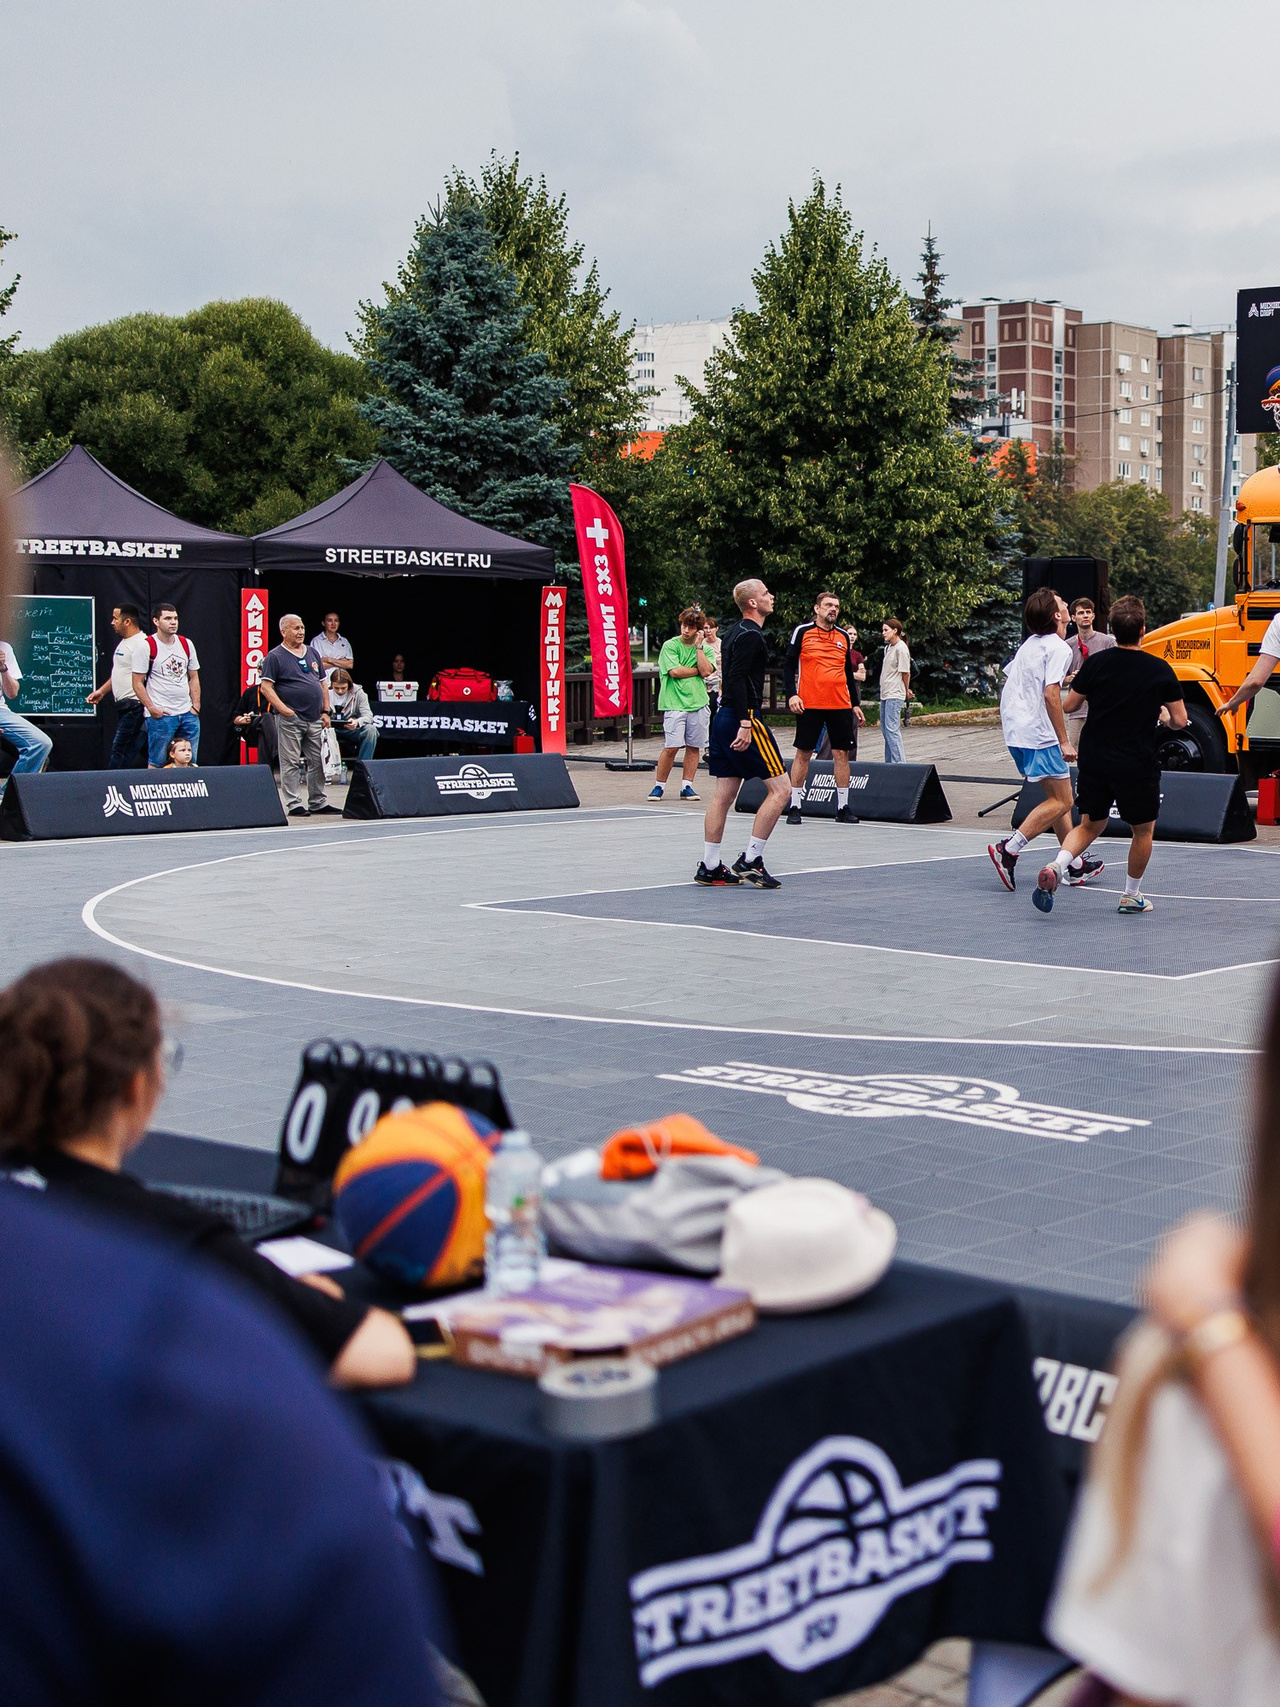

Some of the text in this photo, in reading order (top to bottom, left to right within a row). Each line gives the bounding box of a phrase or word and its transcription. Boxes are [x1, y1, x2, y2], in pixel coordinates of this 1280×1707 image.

[15, 539, 181, 559] TREETBASKET
[325, 548, 491, 568] STREETBASKET.RU
[245, 593, 265, 686] АЙБОЛ
[544, 591, 563, 731] МЕДПУНКТ
[599, 603, 620, 707] АЙБОЛИТ
[372, 715, 508, 734] STREETBASKET
[129, 780, 209, 800] МОСКОВСКИЙ
[437, 778, 515, 789] STREETBASKET
[807, 788, 835, 802] СПОРТ
[134, 800, 172, 816] СПОРТ
[680, 1066, 1133, 1138] STREETBASKET
[286, 1082, 327, 1164] 0
